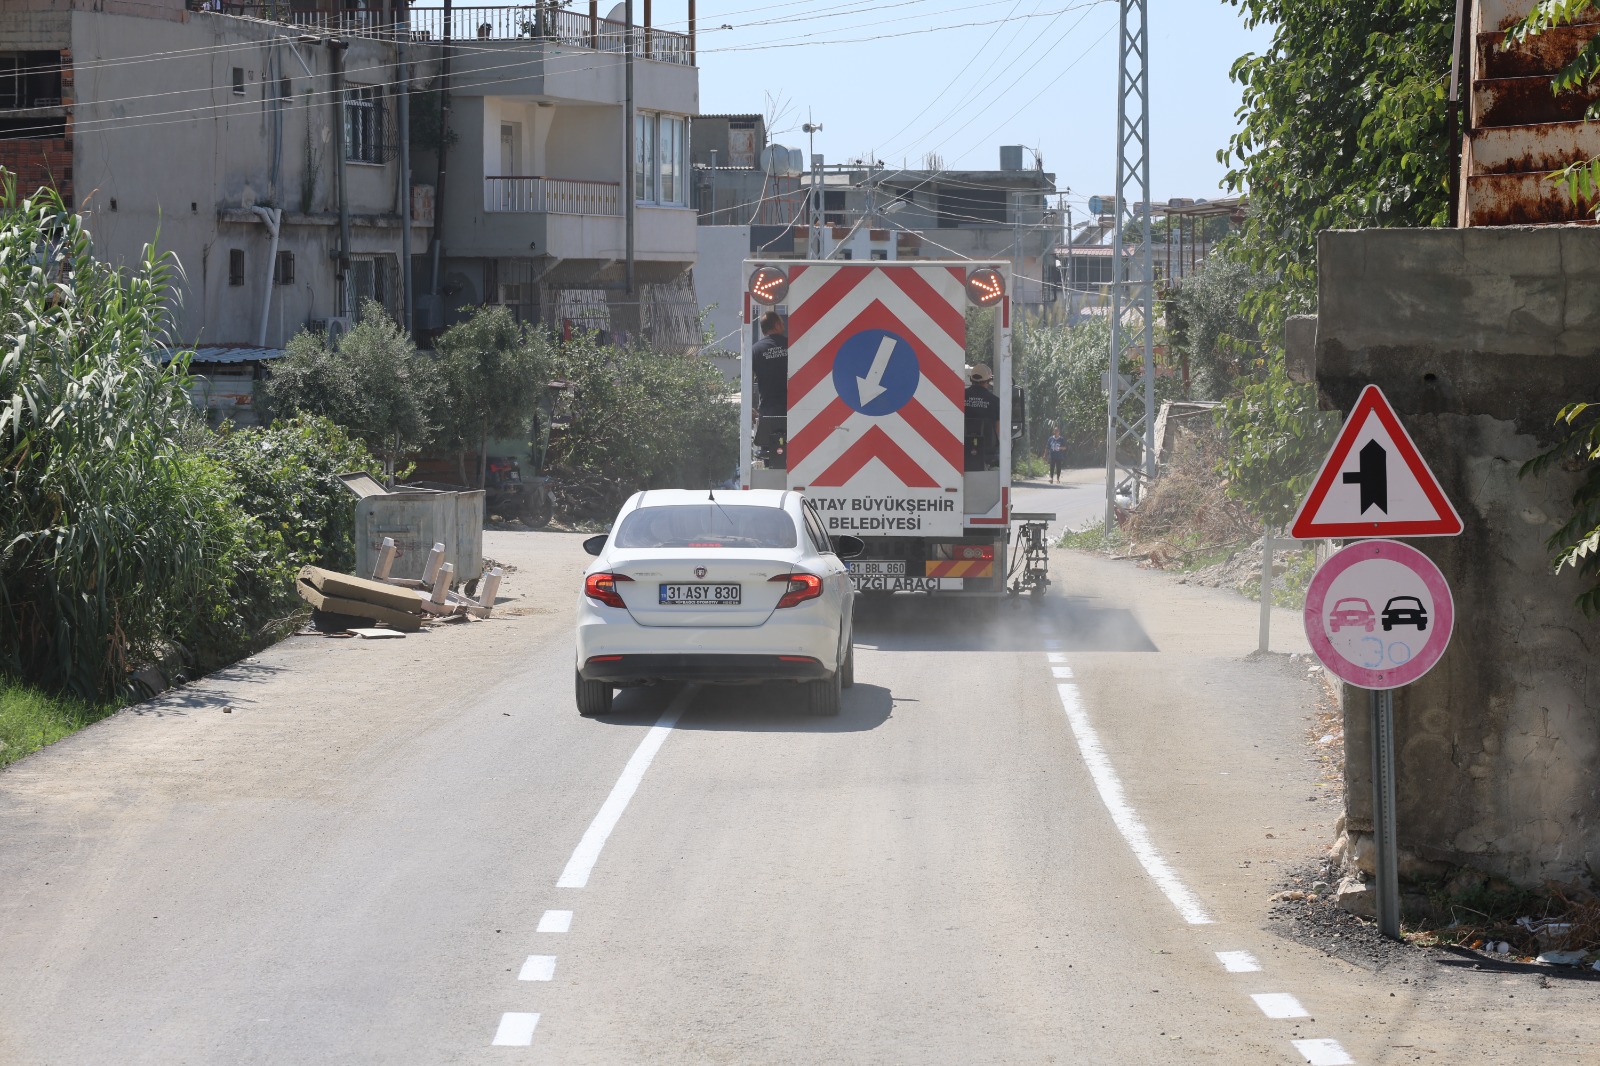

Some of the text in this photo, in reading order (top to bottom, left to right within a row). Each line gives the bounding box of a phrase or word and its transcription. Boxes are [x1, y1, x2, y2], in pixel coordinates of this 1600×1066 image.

[810, 495, 955, 515] ATAY BÜYÜKŞEHİR
[829, 514, 921, 530] BELEDİYESİ
[850, 563, 905, 574] 31 BBL 860
[668, 586, 739, 600] 31 ASY 830
